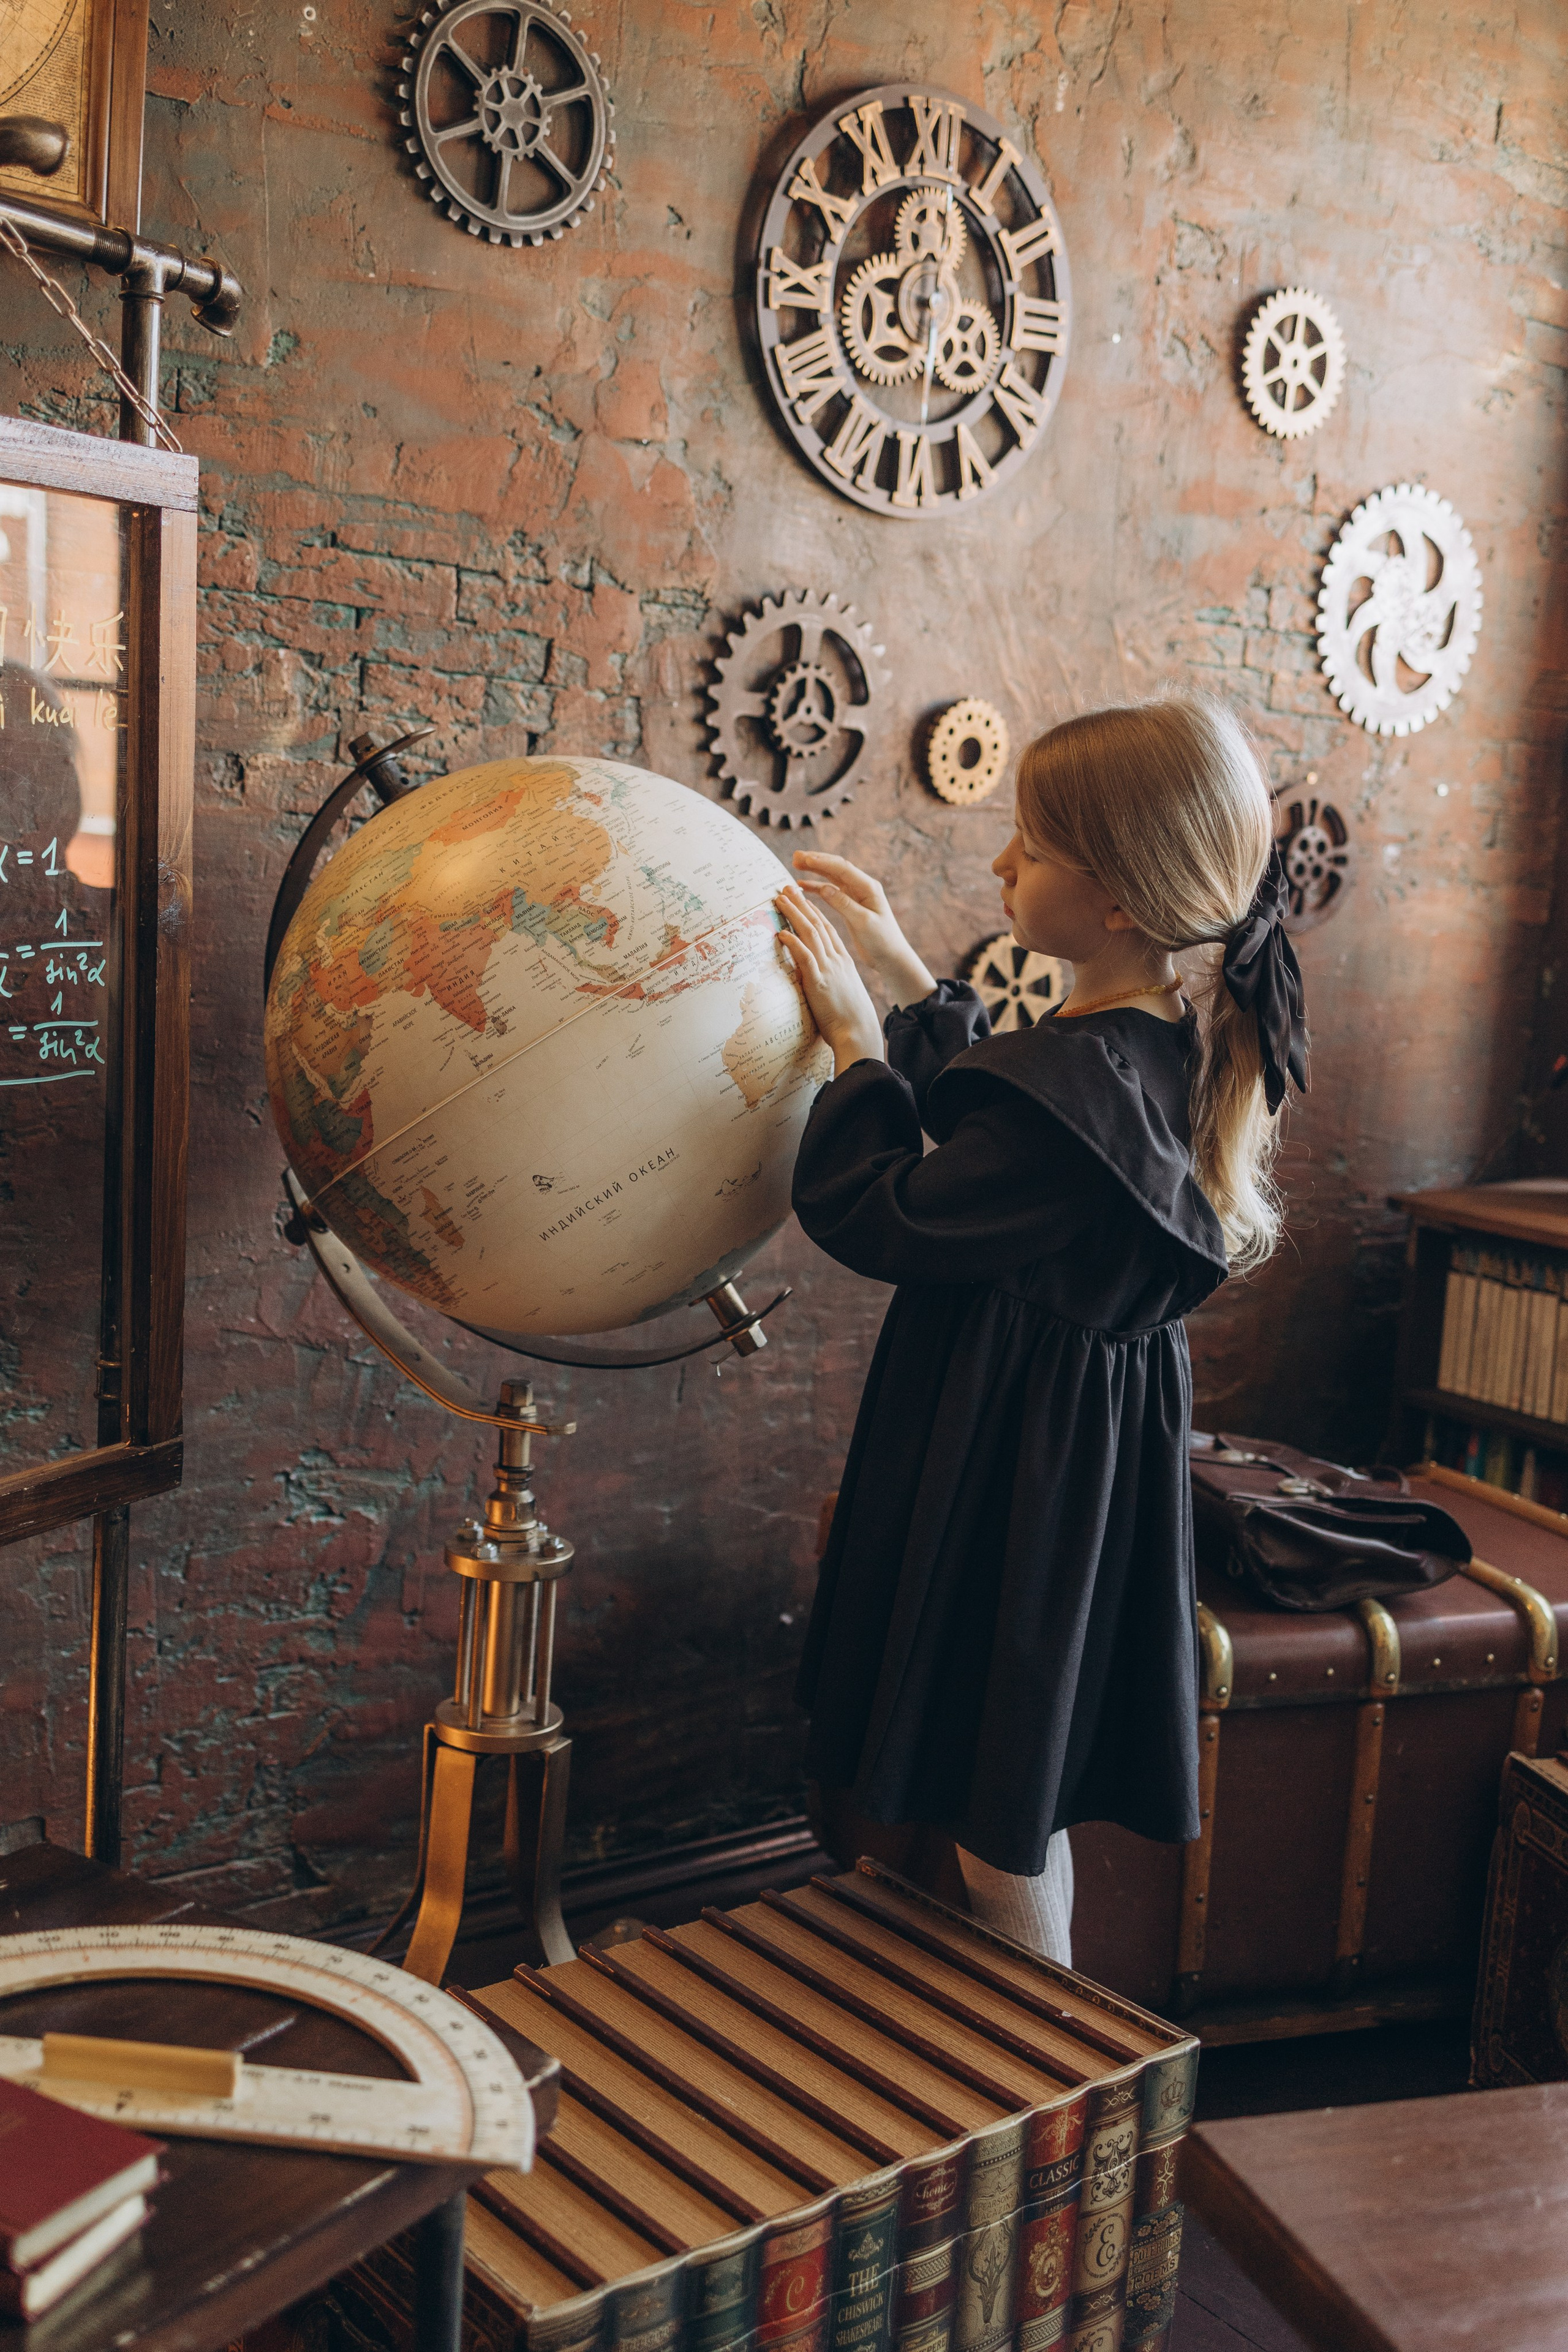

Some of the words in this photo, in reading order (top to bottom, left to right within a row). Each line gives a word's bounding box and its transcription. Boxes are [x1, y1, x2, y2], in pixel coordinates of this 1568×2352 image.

[839, 102, 900, 197] XI
[904, 96, 966, 184] XII
[969, 137, 1022, 216] I
[788, 157, 858, 244] X
[998, 205, 1061, 282] II
[769, 247, 832, 313] IX
[1011, 293, 1065, 356] III
[774, 323, 846, 423] VIII
[993, 363, 1050, 450] IV
[824, 394, 886, 491] VII
[892, 431, 939, 508] VI
[957, 422, 999, 500] V
[0, 602, 126, 676] 快乐
[462, 805, 503, 831] МОНГОЛИЯ
[499, 835, 559, 873] КИТАЙ
[382, 881, 412, 904] КЫРГЫЗСТАН
[560, 888, 572, 897] Ханой
[486, 903, 501, 915] БУТАН
[515, 905, 537, 920] МЬЯНМА
[578, 907, 595, 917] ЛАОС
[442, 921, 458, 932] НЕПАЛ
[481, 912, 507, 930] БАНГЛАДЕШ
[492, 924, 505, 933] Дакка
[560, 922, 582, 938] ТАИЛАНД
[587, 922, 608, 937] КАМБОДЖА
[609, 915, 628, 929] ВЬЕТНАМ
[568, 933, 584, 944] Бангкок
[623, 942, 648, 960] МАЛАЙЗИЯ
[378, 958, 405, 978] ПАКИСТАН
[541, 949, 571, 974] АНДАМАНСКОЕ
[570, 971, 581, 982] МОРЕ
[625, 967, 644, 979] СИНГАПУР
[328, 970, 347, 987] ИРАН
[447, 970, 475, 992] ИНДИЯ
[392, 1008, 418, 1028] АРАВИЙСКОЕ
[402, 1020, 415, 1031] МОРЕ
[491, 1005, 516, 1023] ШРИ-ЛАНКА
[313, 1032, 339, 1055] САУДОВСКАЯ
[358, 1033, 372, 1044] ОМАН
[764, 1019, 804, 1047] АВСТРАЛИЯ
[322, 1045, 337, 1060] АРАВИЯ
[739, 1044, 761, 1060] ЗАПАДНАЯ
[539, 1181, 623, 1242] ИНДИЙСКИЙ
[628, 1147, 675, 1183] ОКЕАН
[1030, 2155, 1080, 2190] CLASSIC
[923, 2184, 950, 2199] home
[1096, 2223, 1115, 2267] E
[849, 2263, 880, 2297] THE
[1133, 2259, 1177, 2286] POEMS
[838, 2291, 884, 2324] CHISWICK
[835, 2313, 884, 2346] SHAKESPEARE
